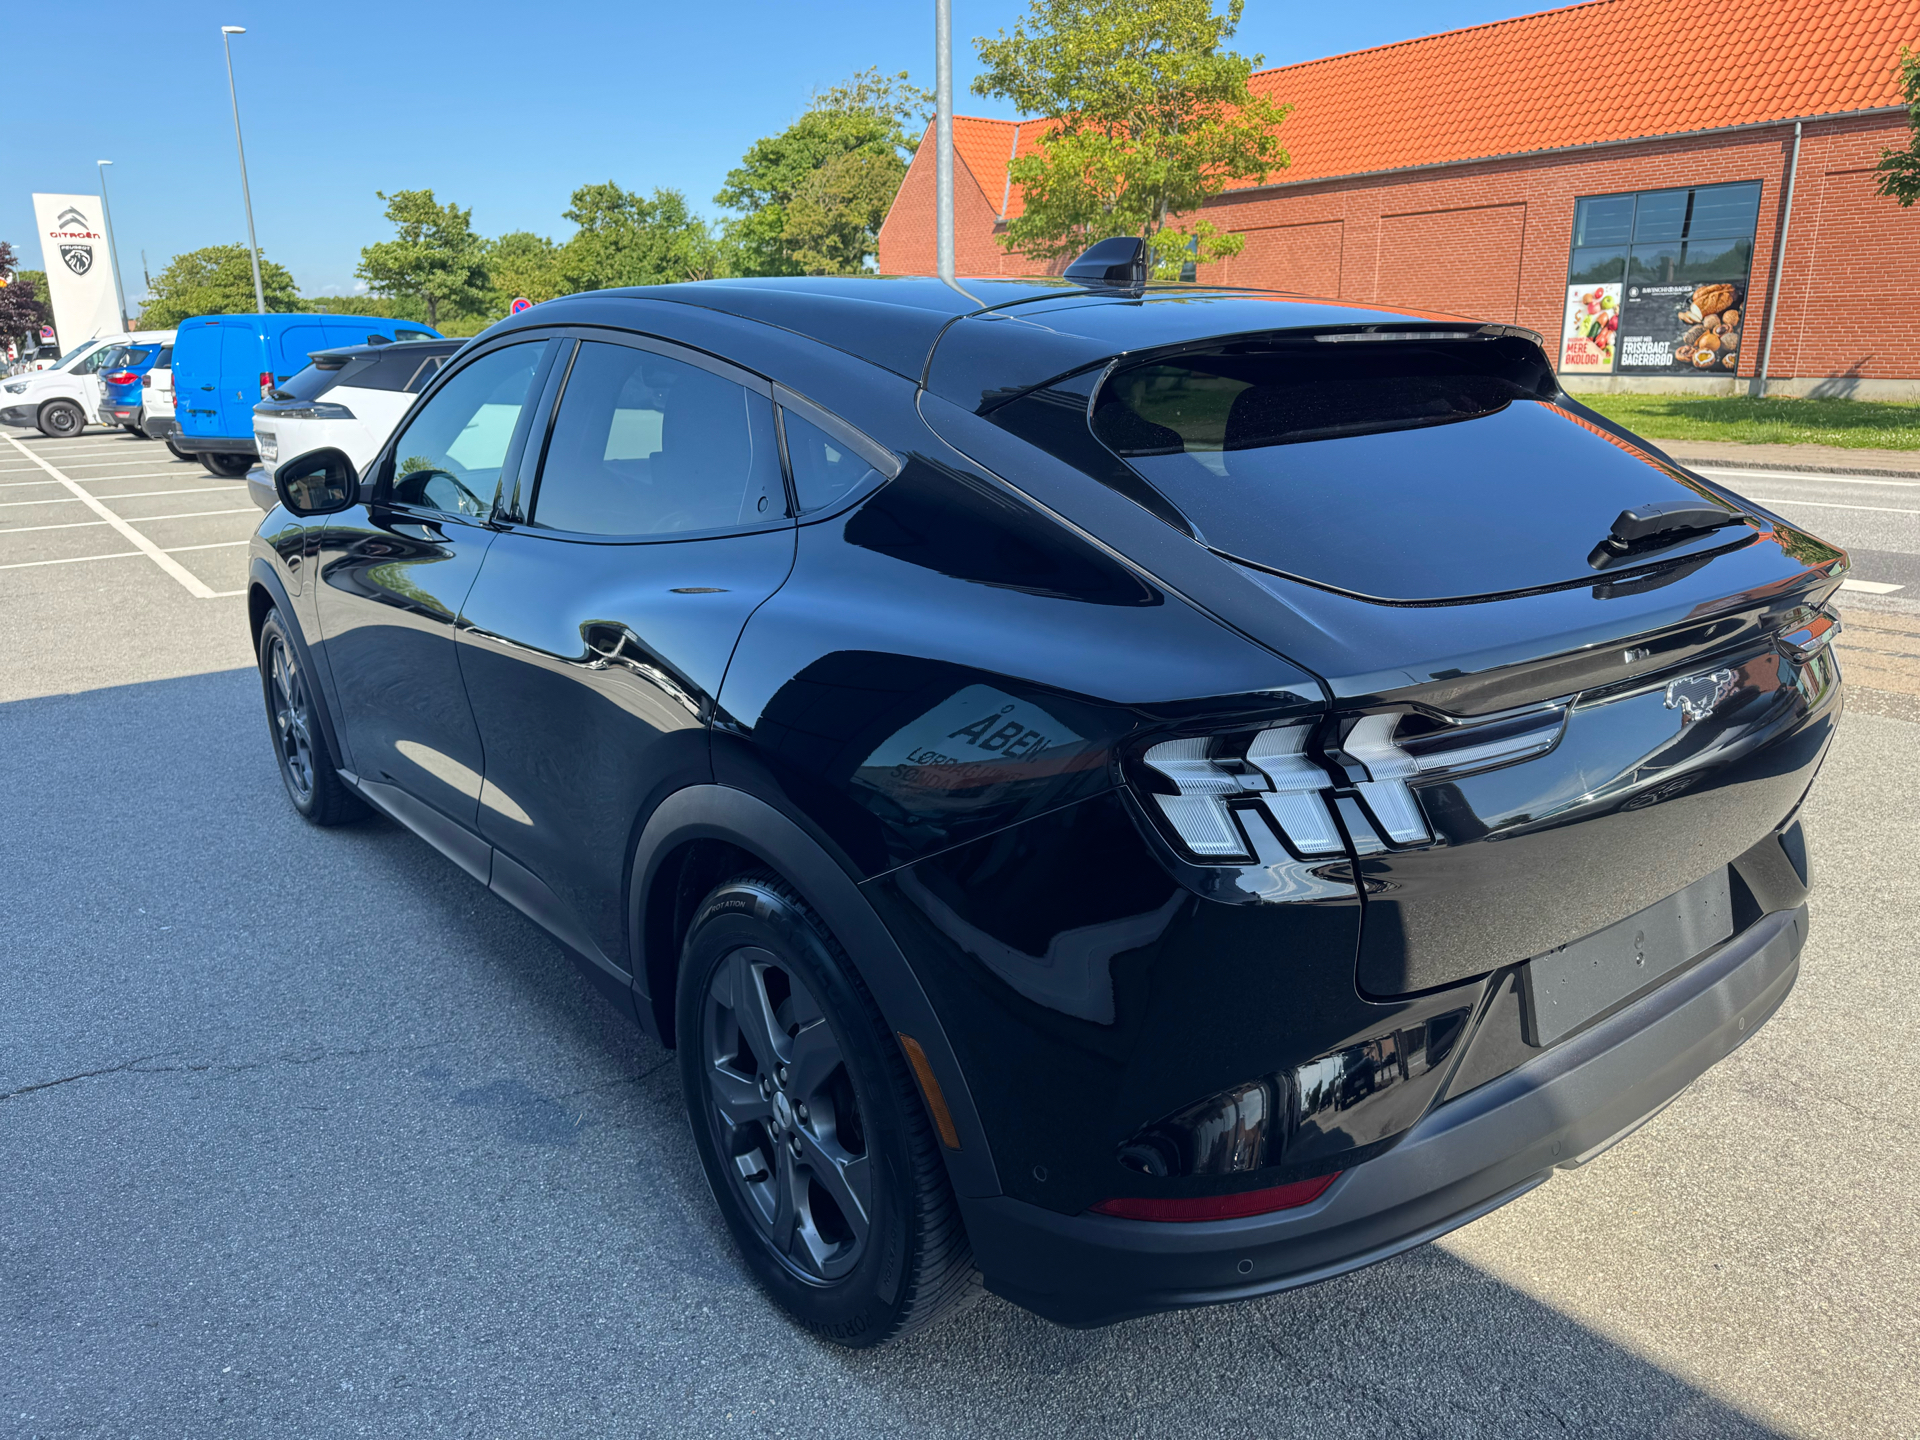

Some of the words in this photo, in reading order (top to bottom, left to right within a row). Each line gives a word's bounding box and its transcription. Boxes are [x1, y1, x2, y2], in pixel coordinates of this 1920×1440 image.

[1566, 343, 1588, 353] MERE
[1622, 342, 1670, 354] FRISKBAGT
[1565, 354, 1599, 365] ØKOLOGI
[1621, 354, 1673, 366] BAGERBRØD
[947, 704, 1052, 763] ÅBEN
[711, 900, 746, 913] ROTATION
